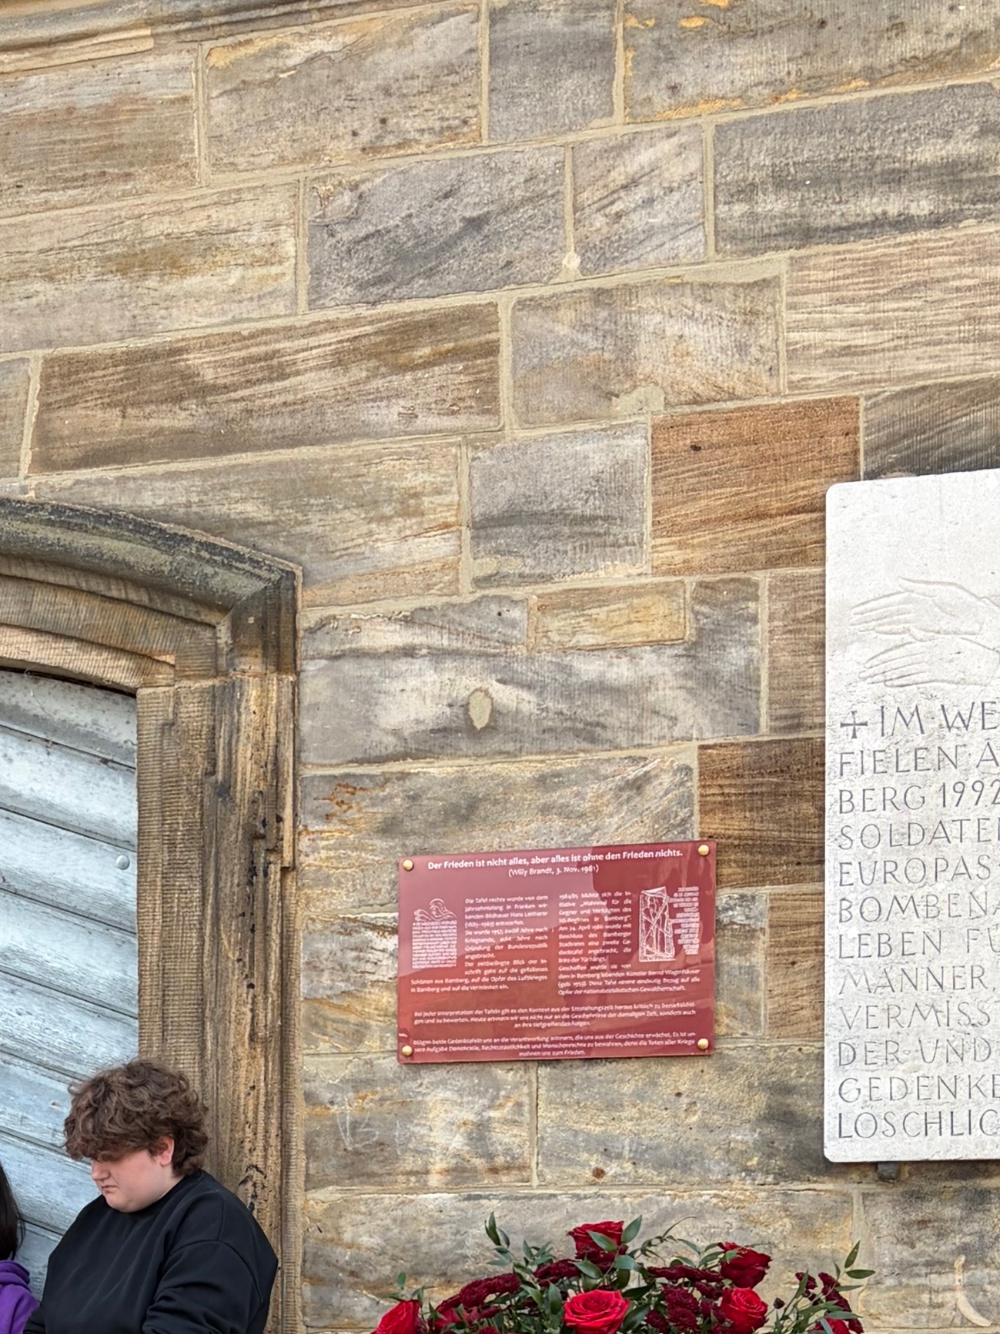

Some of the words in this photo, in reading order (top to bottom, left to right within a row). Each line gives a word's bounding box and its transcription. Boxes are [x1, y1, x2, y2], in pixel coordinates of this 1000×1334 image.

[880, 704, 925, 737] IM
[940, 701, 998, 732] WE
[839, 745, 961, 777] FIELEN
[839, 785, 925, 814] BERG
[838, 817, 1000, 850] SOLDATE
[444, 860, 474, 869] Frieden
[475, 859, 485, 867] ist
[486, 858, 507, 866] nicht
[509, 857, 529, 865] alles,
[531, 856, 550, 864] aber
[551, 854, 570, 863] alles
[571, 854, 581, 862] ist
[583, 853, 604, 862] ohne
[605, 852, 621, 860] den
[623, 850, 654, 859] Frieden
[655, 849, 683, 858] nichts.
[529, 867, 554, 875] Brandt,
[839, 854, 991, 887] EUROPAS
[838, 929, 942, 960] LEBEN
[838, 1040, 904, 1067] DER
[918, 1037, 992, 1064] UND
